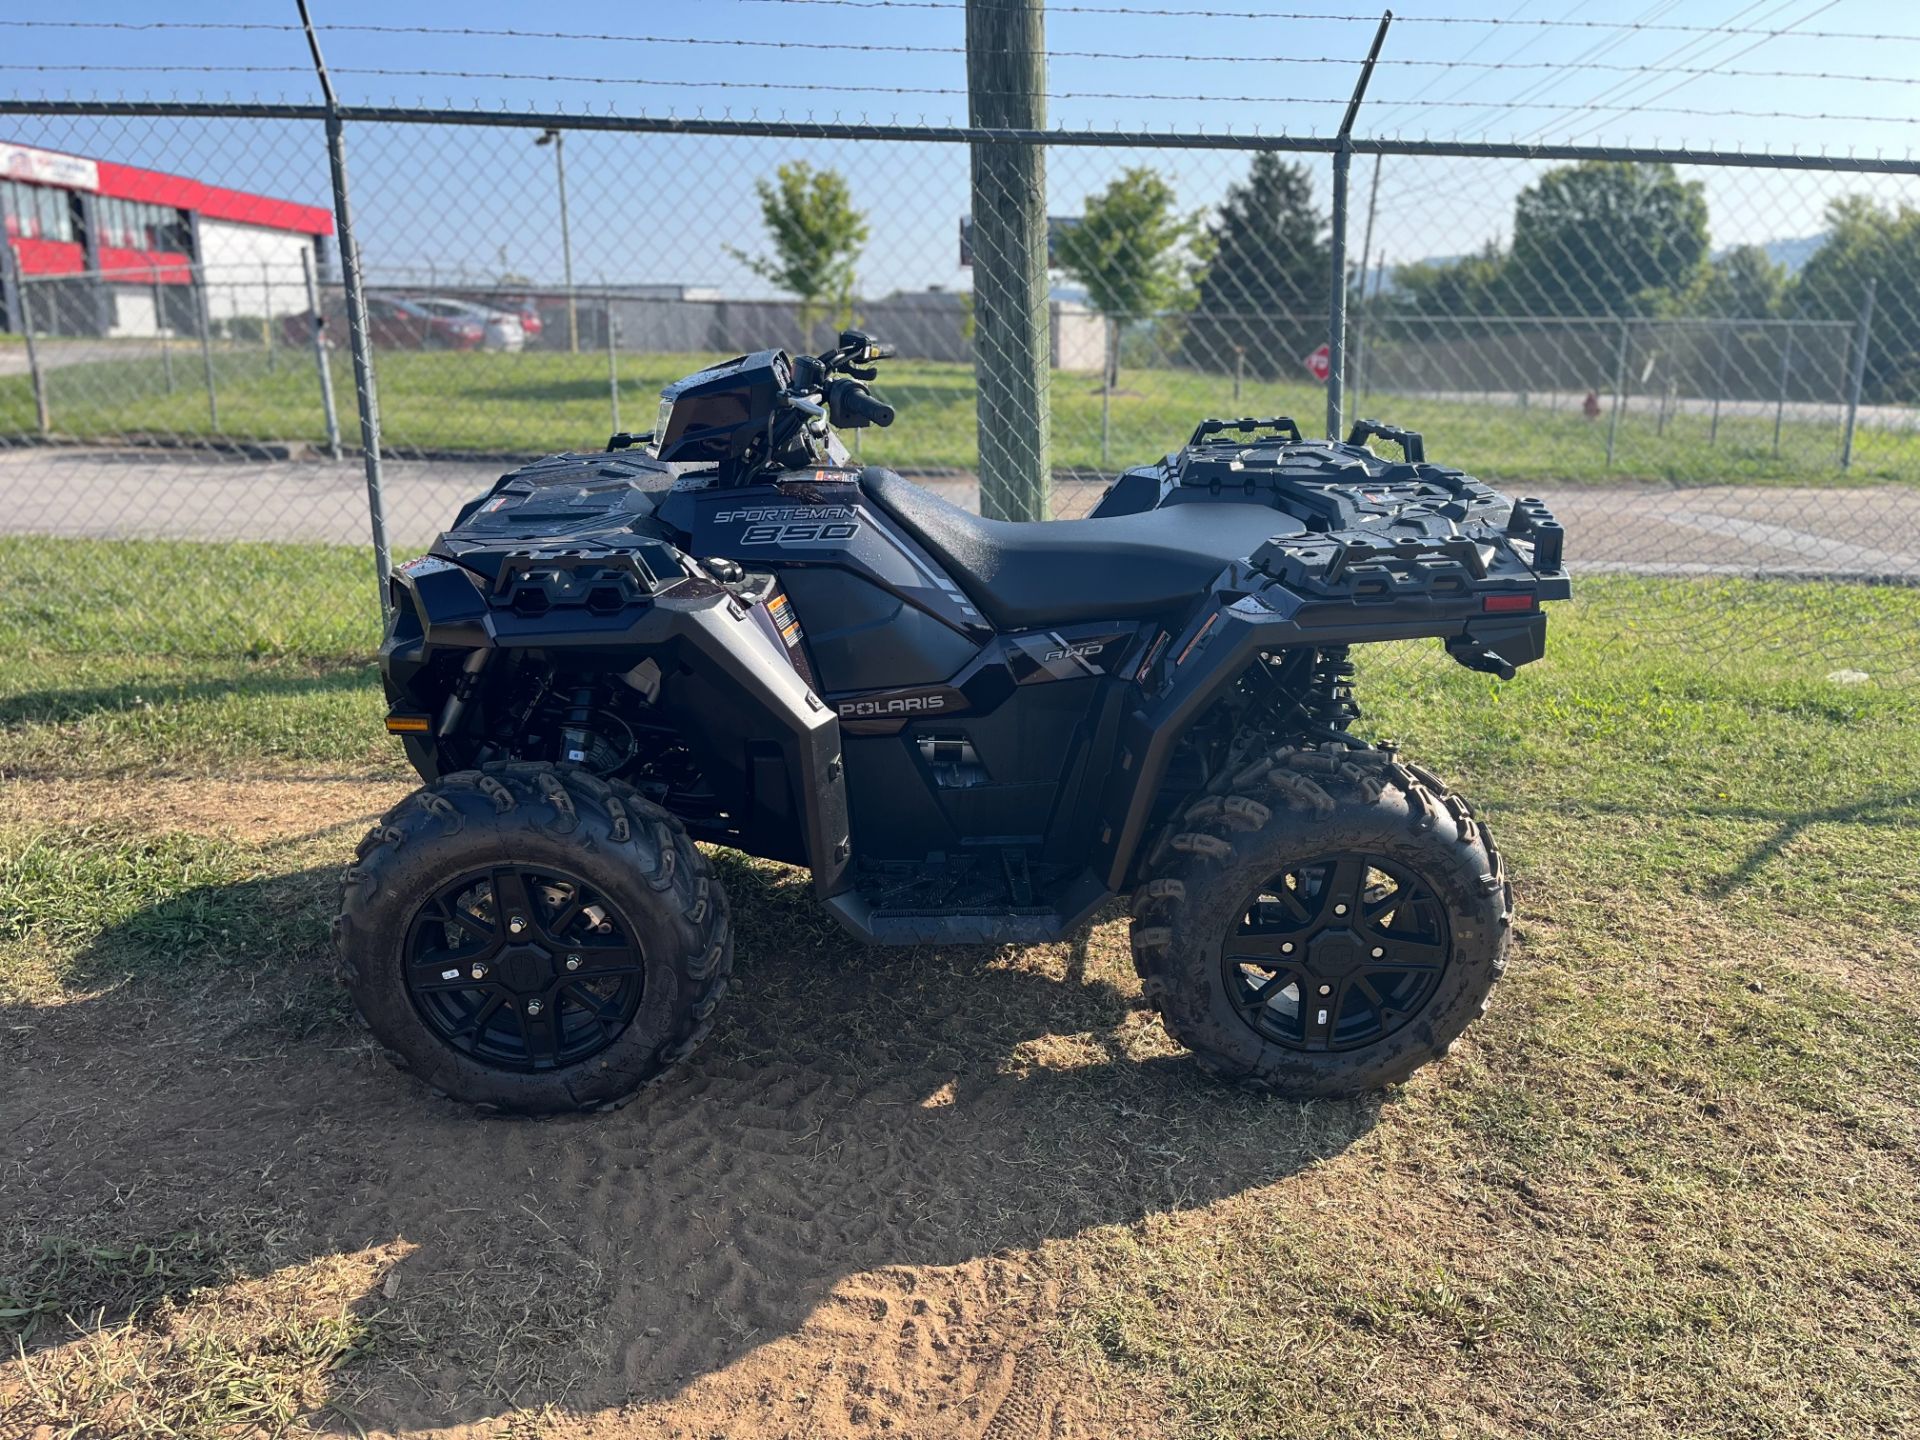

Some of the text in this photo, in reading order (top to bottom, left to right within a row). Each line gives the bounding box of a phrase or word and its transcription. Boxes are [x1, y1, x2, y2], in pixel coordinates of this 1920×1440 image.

[713, 506, 859, 523] SPORTSMAN
[740, 523, 861, 545] 850
[1044, 644, 1104, 662] AWD
[839, 696, 945, 716] POLARIS
